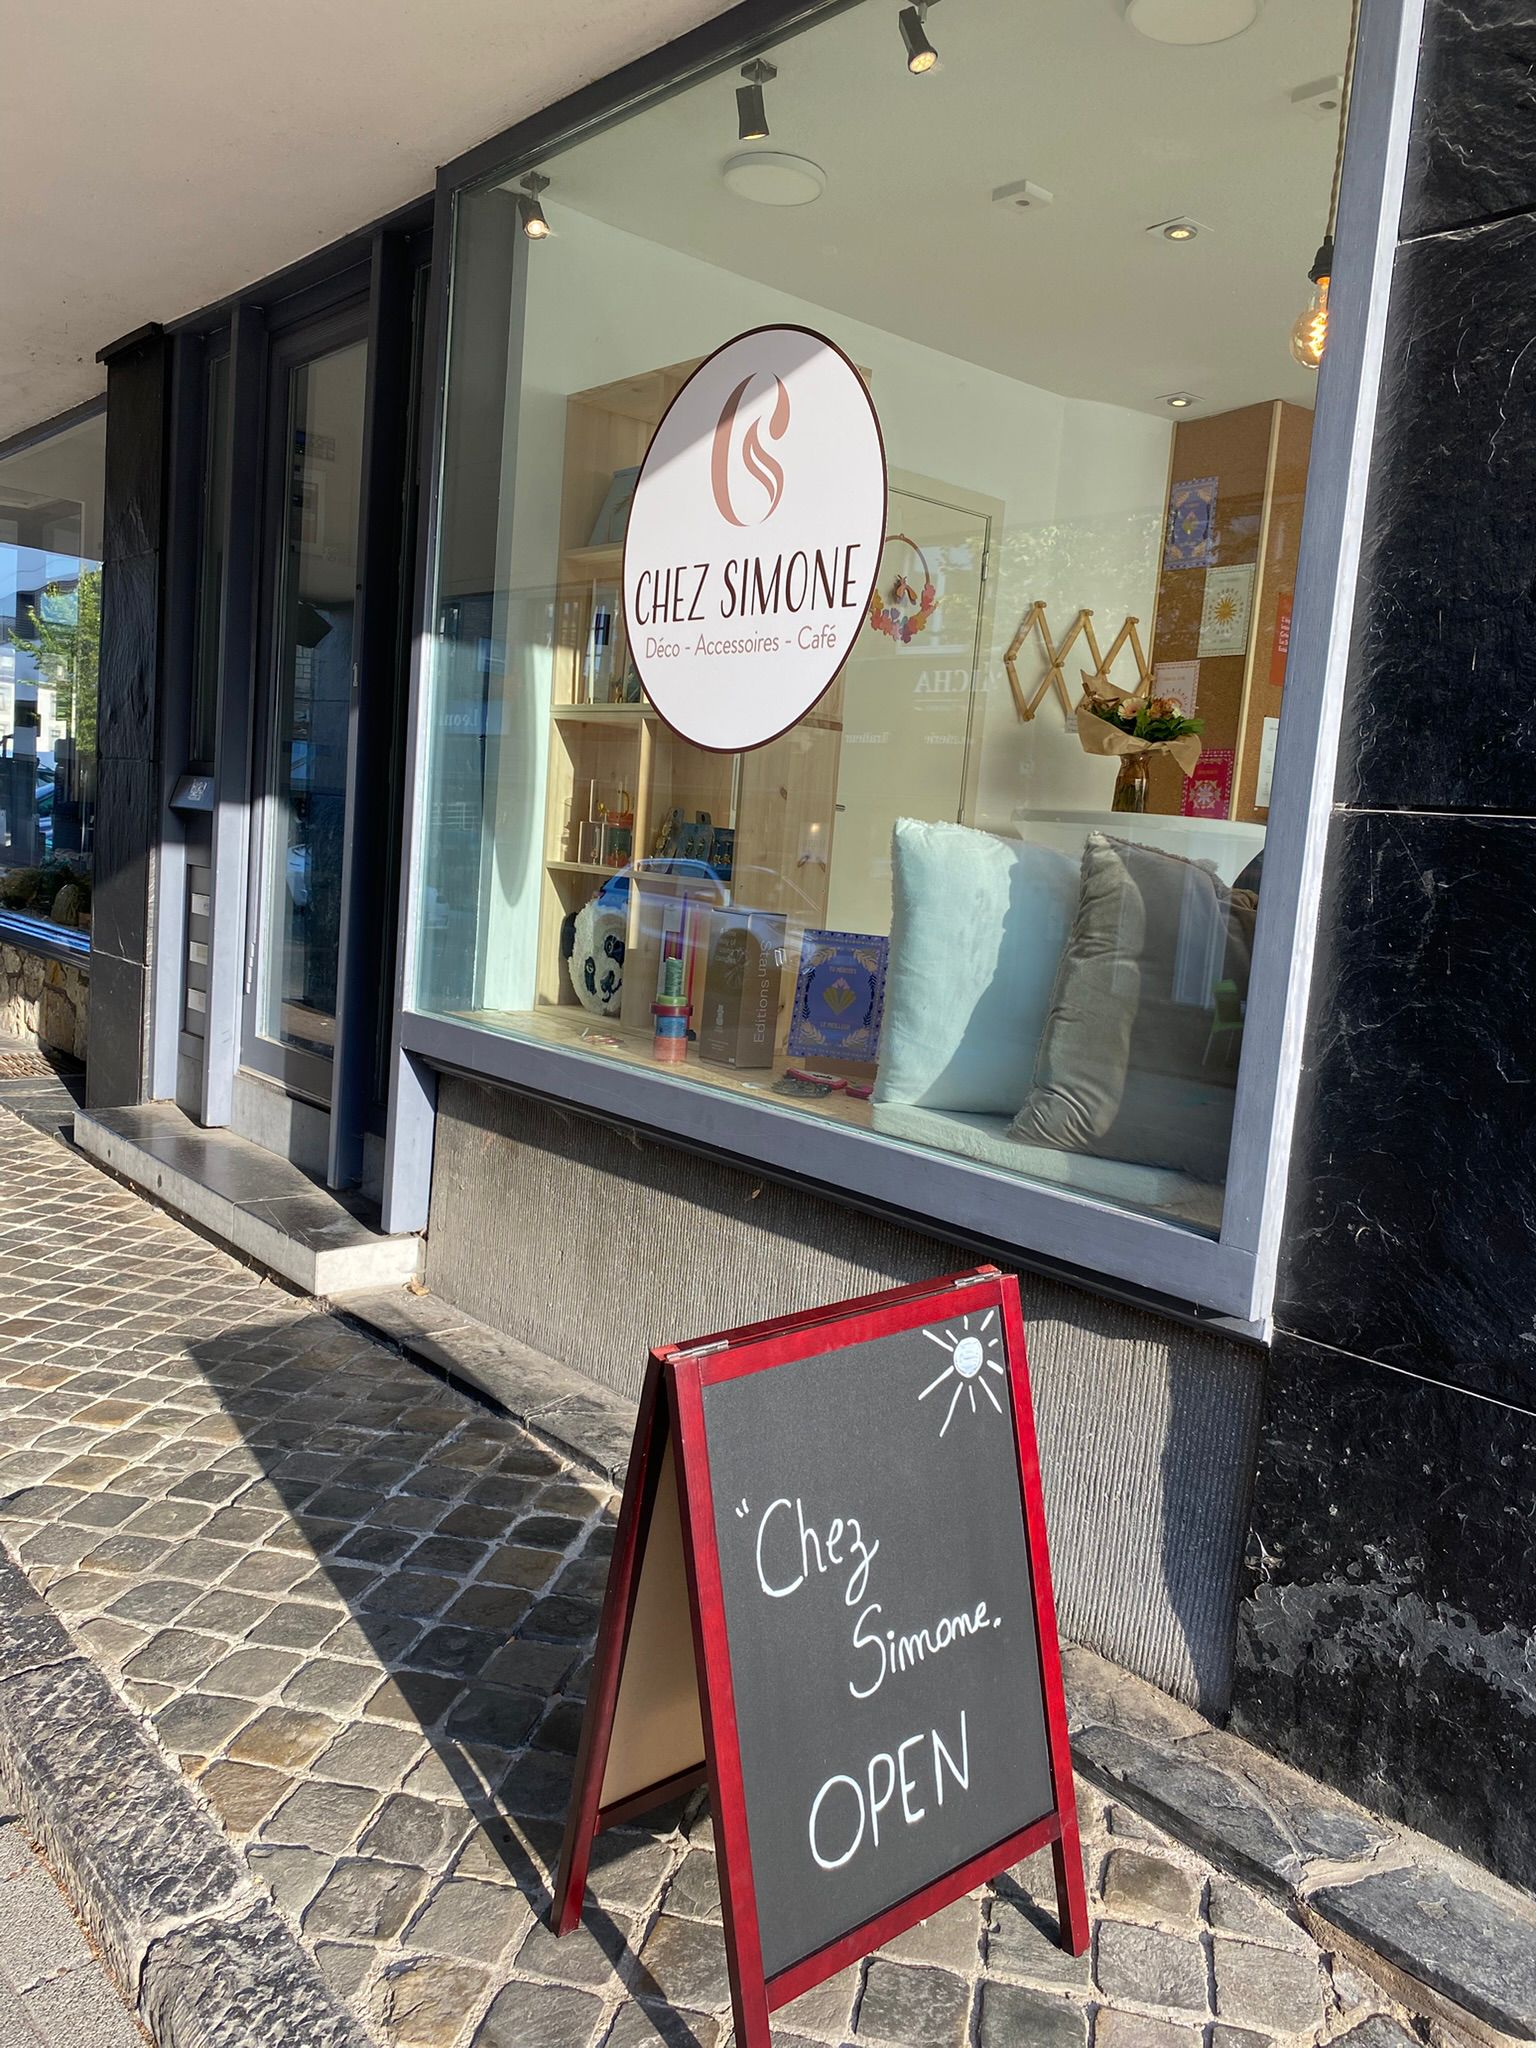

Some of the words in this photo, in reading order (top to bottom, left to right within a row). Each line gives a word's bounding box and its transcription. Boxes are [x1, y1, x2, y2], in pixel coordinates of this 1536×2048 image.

[635, 563, 710, 625] CHEZ
[720, 544, 861, 619] SIMONE
[645, 636, 680, 658] Déco
[694, 630, 779, 656] Accessoires
[798, 624, 836, 649] Café
[753, 980, 770, 1043] Editions
[809, 1710, 969, 1869] OPEN
